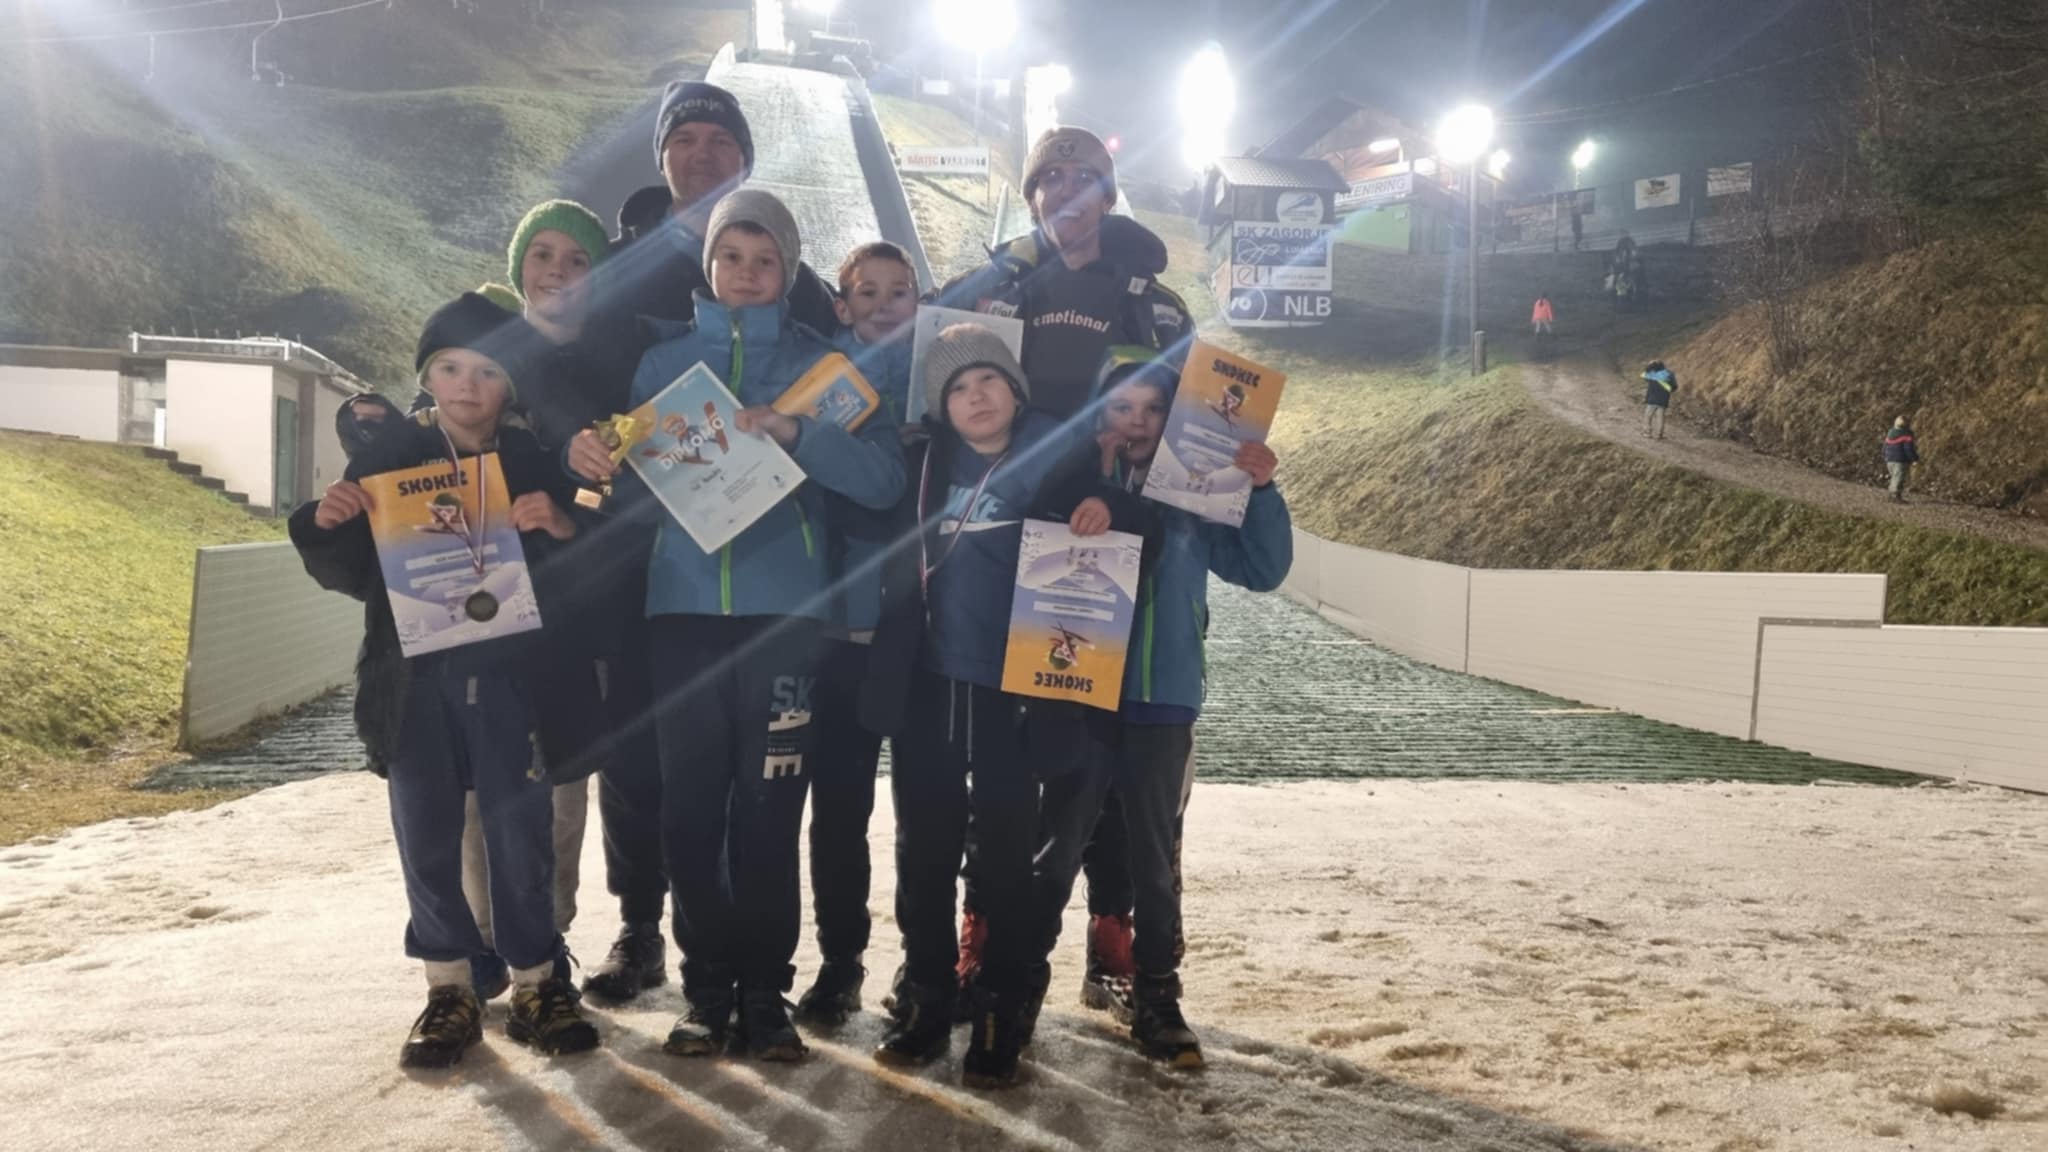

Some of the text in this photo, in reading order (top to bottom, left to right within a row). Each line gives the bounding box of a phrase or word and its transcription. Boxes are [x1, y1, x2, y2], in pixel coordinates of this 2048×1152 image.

[1237, 226, 1257, 238] SK
[1284, 296, 1332, 317] NLB
[1033, 309, 1111, 333] emotional
[1211, 357, 1261, 388] SKOKEC
[1034, 671, 1094, 693] SKOKEC
